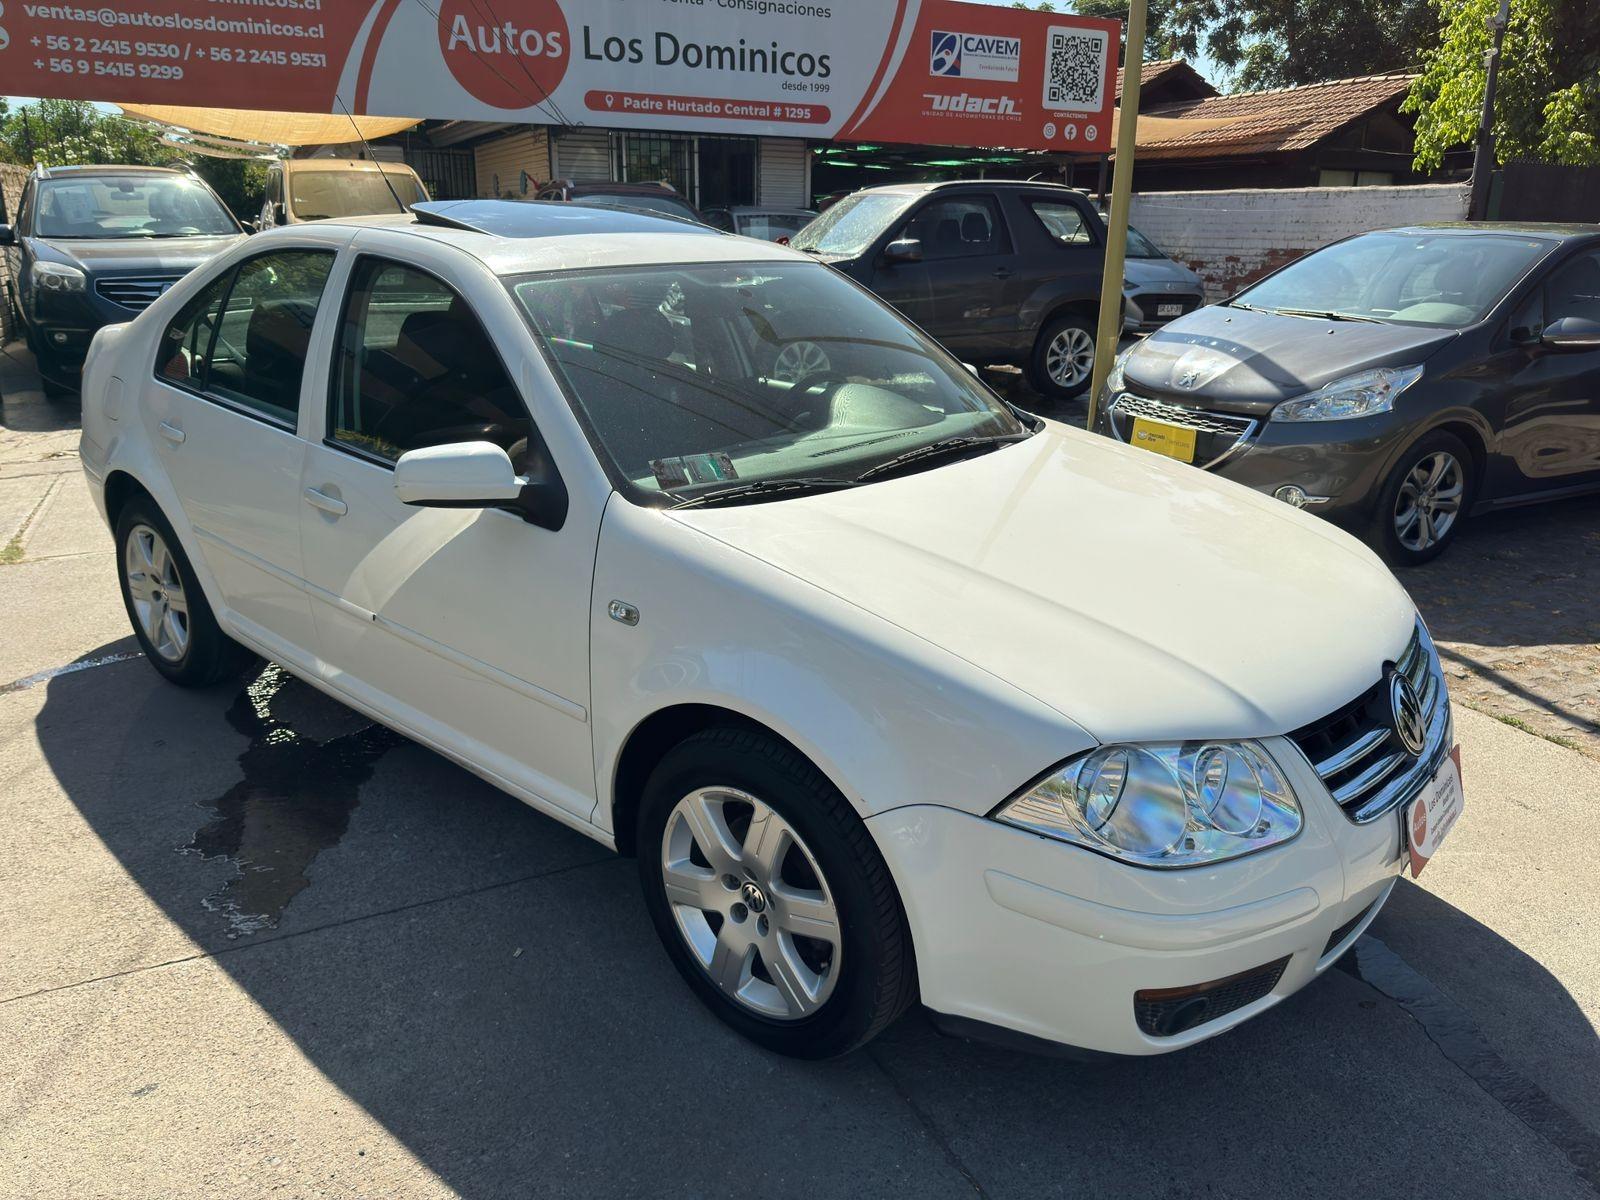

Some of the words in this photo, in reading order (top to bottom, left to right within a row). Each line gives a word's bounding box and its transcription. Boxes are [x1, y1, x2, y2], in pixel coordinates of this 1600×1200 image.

[717, 0, 831, 18] Consignaciones
[23, 4, 324, 38] ventas@autoslosdominicos.cl
[447, 14, 563, 58] Autos
[963, 37, 1019, 56] CAVEM
[30, 36, 41, 47] +
[46, 35, 71, 51] 56
[73, 37, 87, 52] 2
[89, 38, 131, 55] 2415
[134, 42, 180, 58] 9530
[184, 43, 191, 60] /
[210, 47, 233, 61] 56
[235, 48, 247, 62] 2
[249, 49, 287, 65] 2415
[290, 52, 327, 67] 9531
[583, 25, 644, 64] Los
[655, 31, 831, 78] Dominicos
[33, 59, 44, 69] +
[50, 57, 74, 73] 56
[76, 59, 90, 74] 9
[94, 61, 136, 77] 5415
[138, 63, 184, 80] 9299
[781, 81, 808, 92] desde
[809, 82, 830, 93] 1999
[623, 96, 663, 110] Padre
[667, 99, 721, 114] Hurtado
[724, 102, 770, 117] Central
[772, 106, 782, 117] #
[785, 106, 811, 119] 1295
[922, 93, 1022, 115] udach
